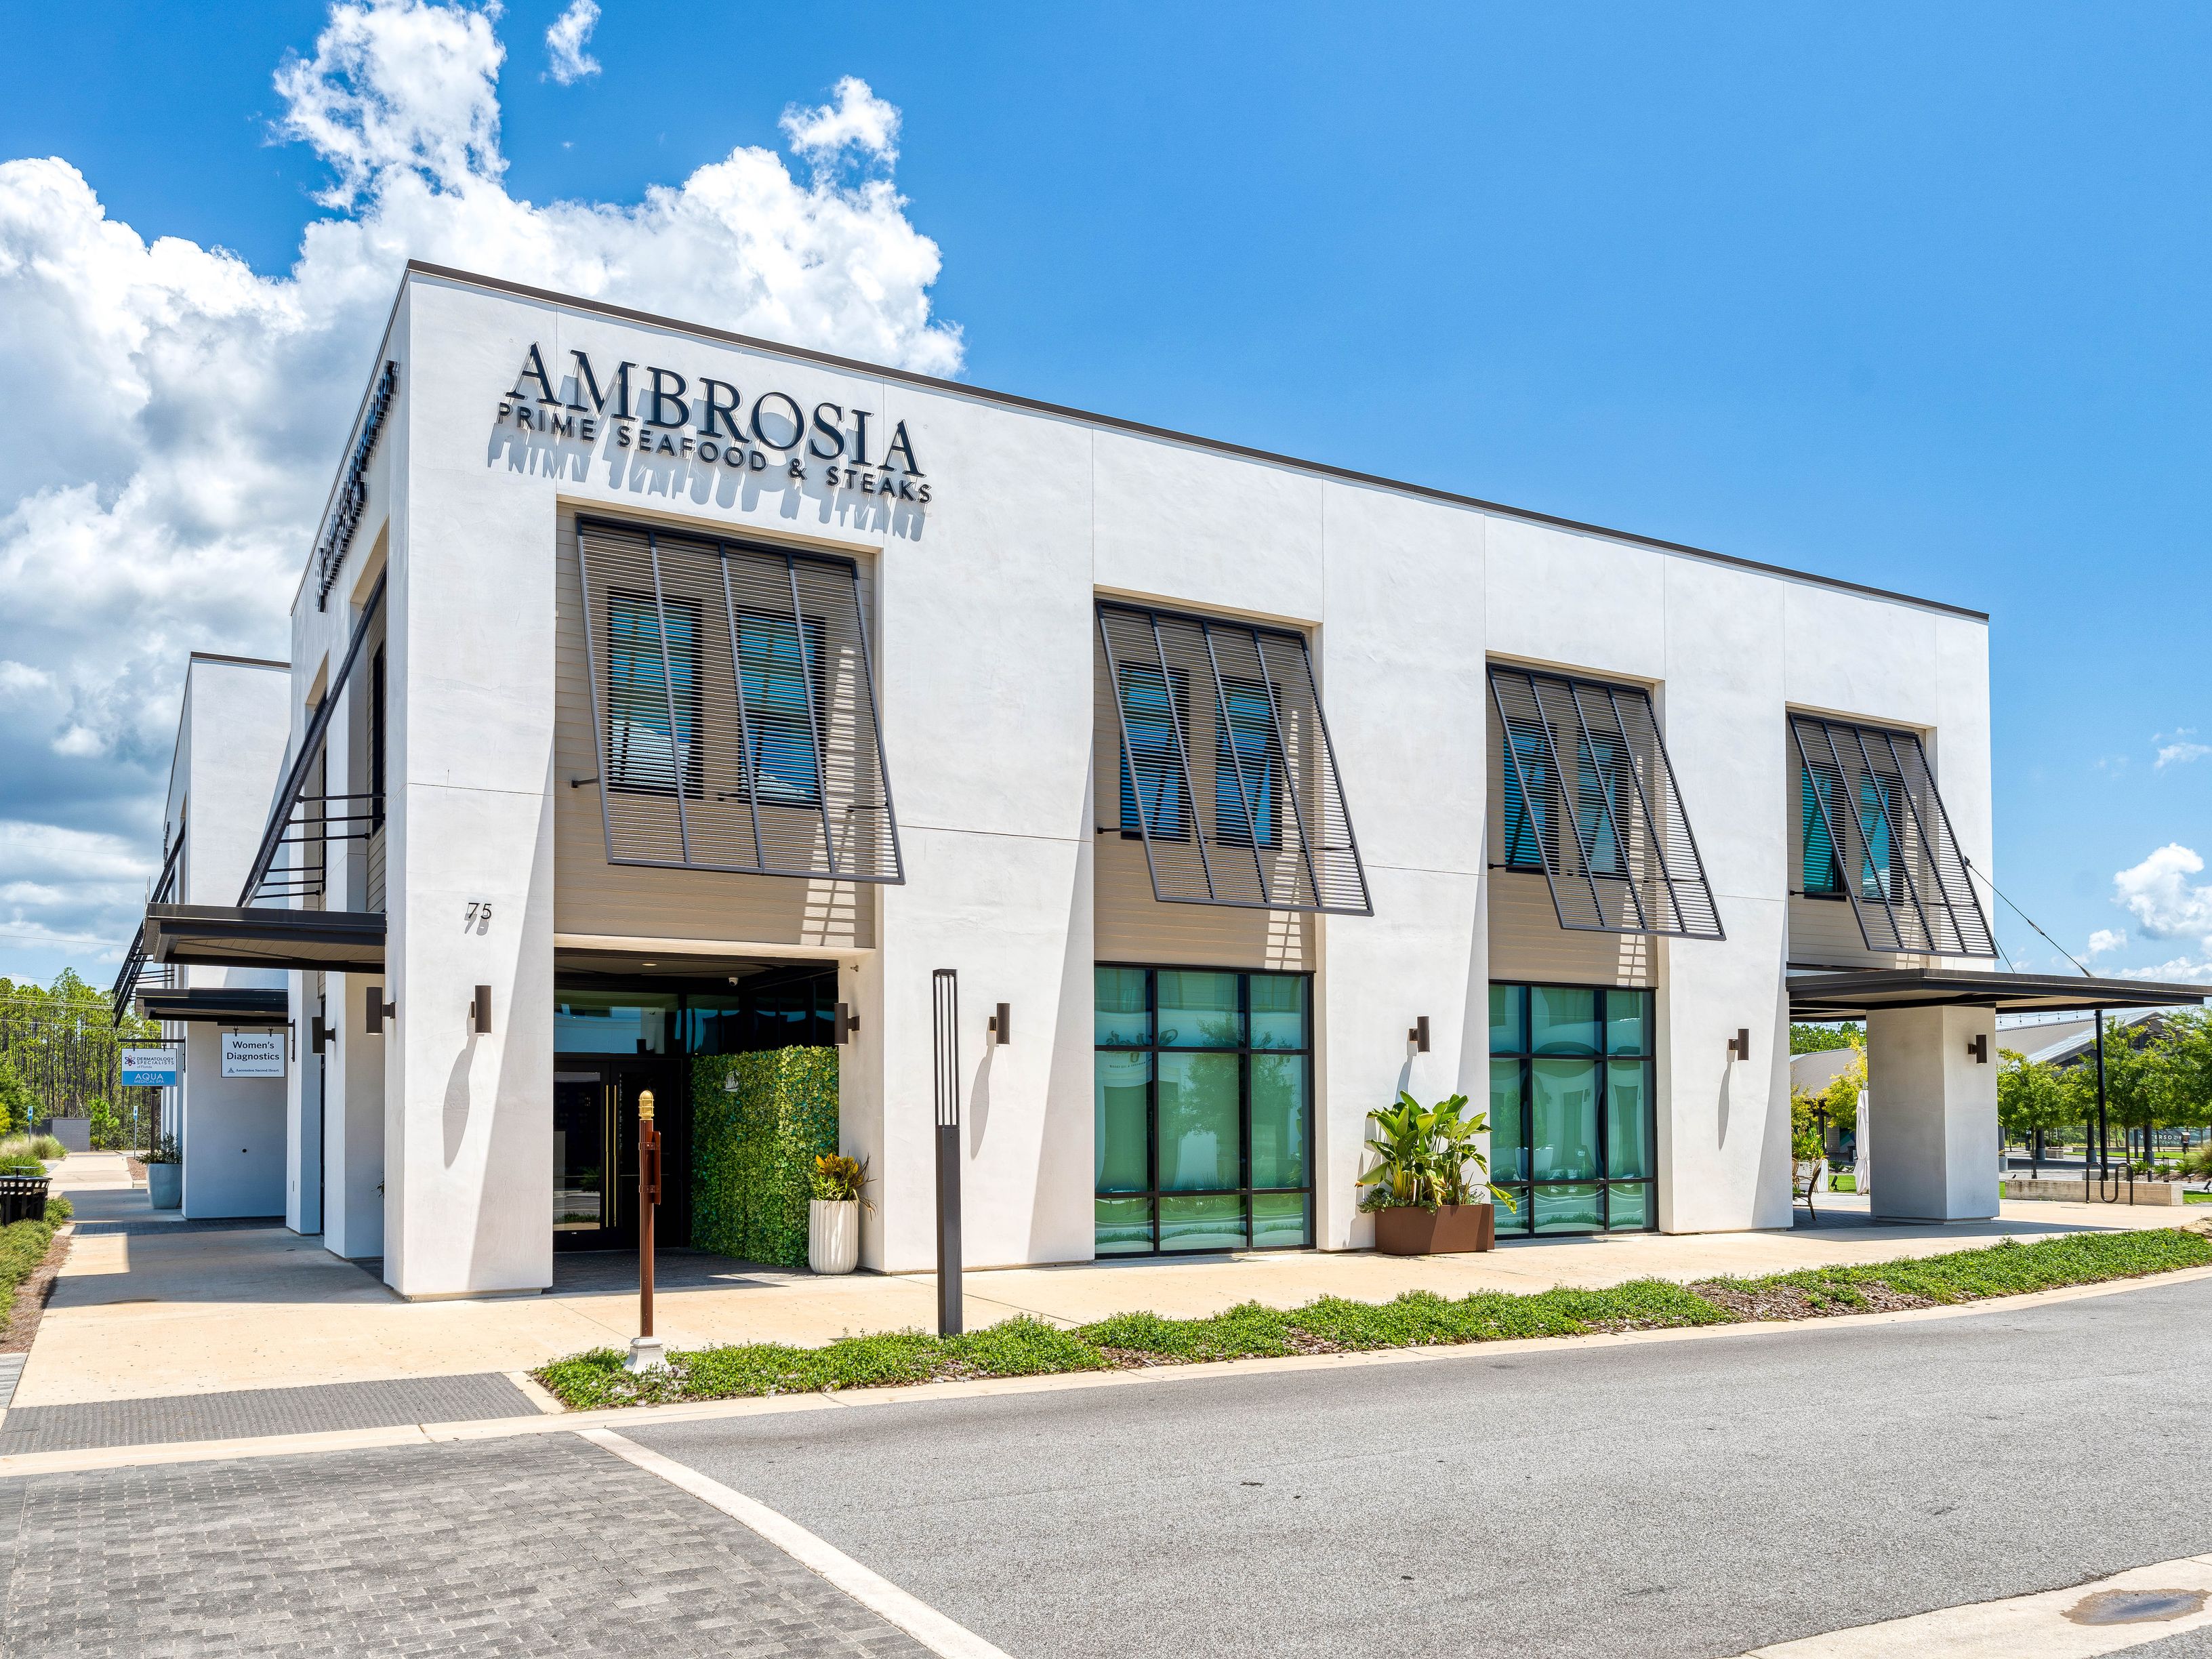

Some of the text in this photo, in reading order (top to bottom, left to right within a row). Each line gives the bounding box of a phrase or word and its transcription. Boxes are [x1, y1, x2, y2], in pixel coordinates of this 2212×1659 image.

[504, 341, 926, 478] AMBROSIA
[497, 401, 933, 504] PRIME SEAFOOD & STEAKS
[468, 902, 492, 920] 75
[232, 1041, 274, 1049] Women's
[226, 1052, 280, 1062] Diagnostics
